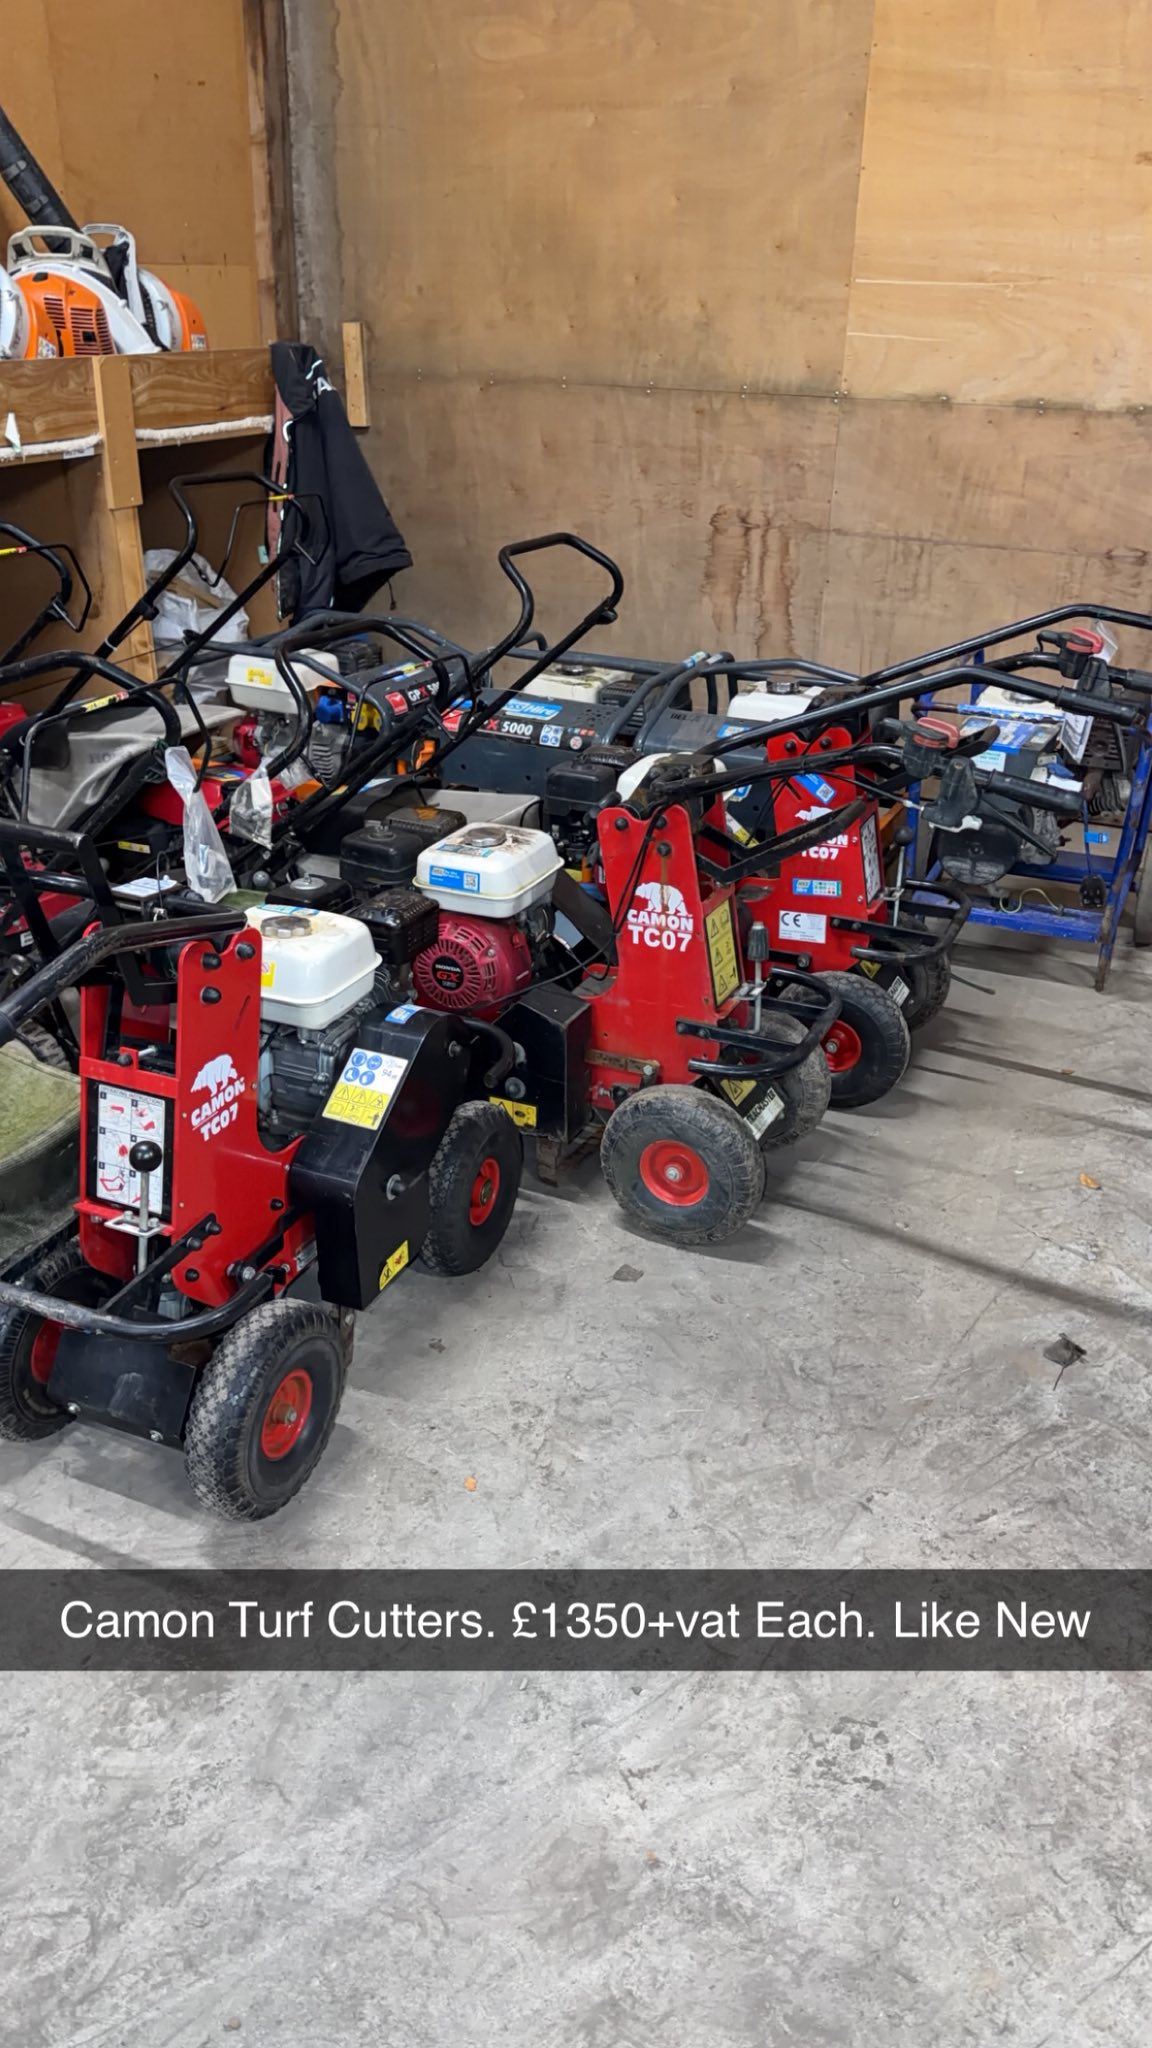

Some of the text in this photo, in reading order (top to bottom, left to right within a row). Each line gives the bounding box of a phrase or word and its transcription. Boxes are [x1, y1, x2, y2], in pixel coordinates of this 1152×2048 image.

[407, 686, 430, 702] GPX
[501, 720, 533, 736] 5000
[626, 908, 694, 932] CAMON
[627, 924, 692, 952] TC07
[436, 970, 461, 982] GX
[190, 1078, 246, 1127] CAMON
[200, 1102, 239, 1142] TC07
